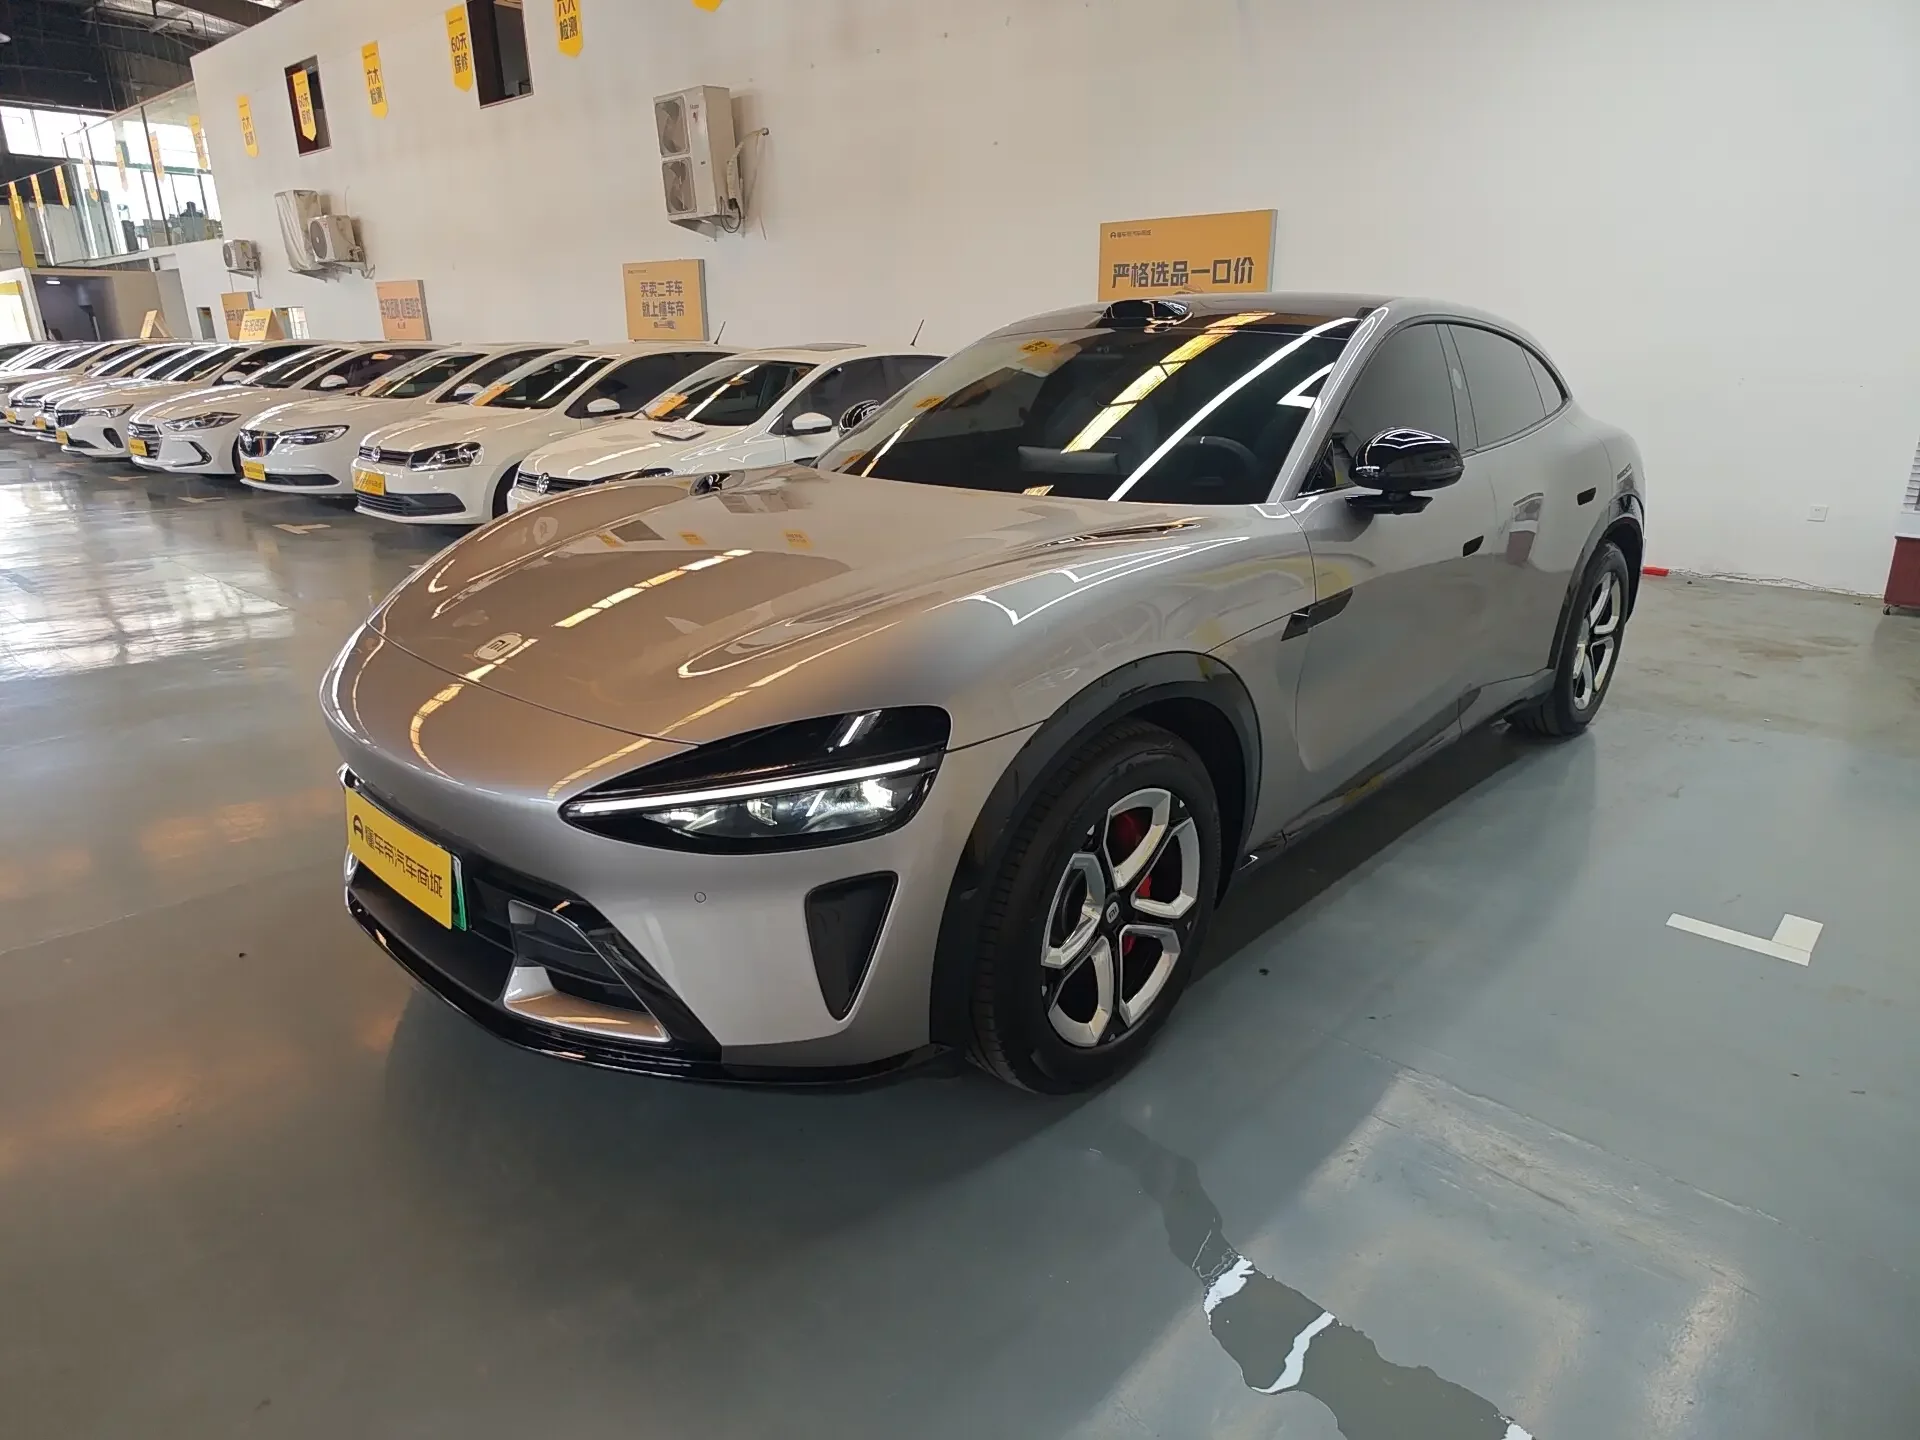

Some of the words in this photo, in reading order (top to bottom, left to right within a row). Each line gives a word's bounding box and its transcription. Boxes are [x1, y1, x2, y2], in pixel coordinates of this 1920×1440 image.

[560, 15, 578, 41] 检测
[451, 32, 468, 53] 60天
[454, 52, 469, 74] 保修
[367, 65, 381, 87] 六大
[1111, 256, 1255, 289] 严格选品一口价
[640, 280, 684, 298] 买卖二手车
[365, 826, 443, 899] 懂车帝汽车商城
